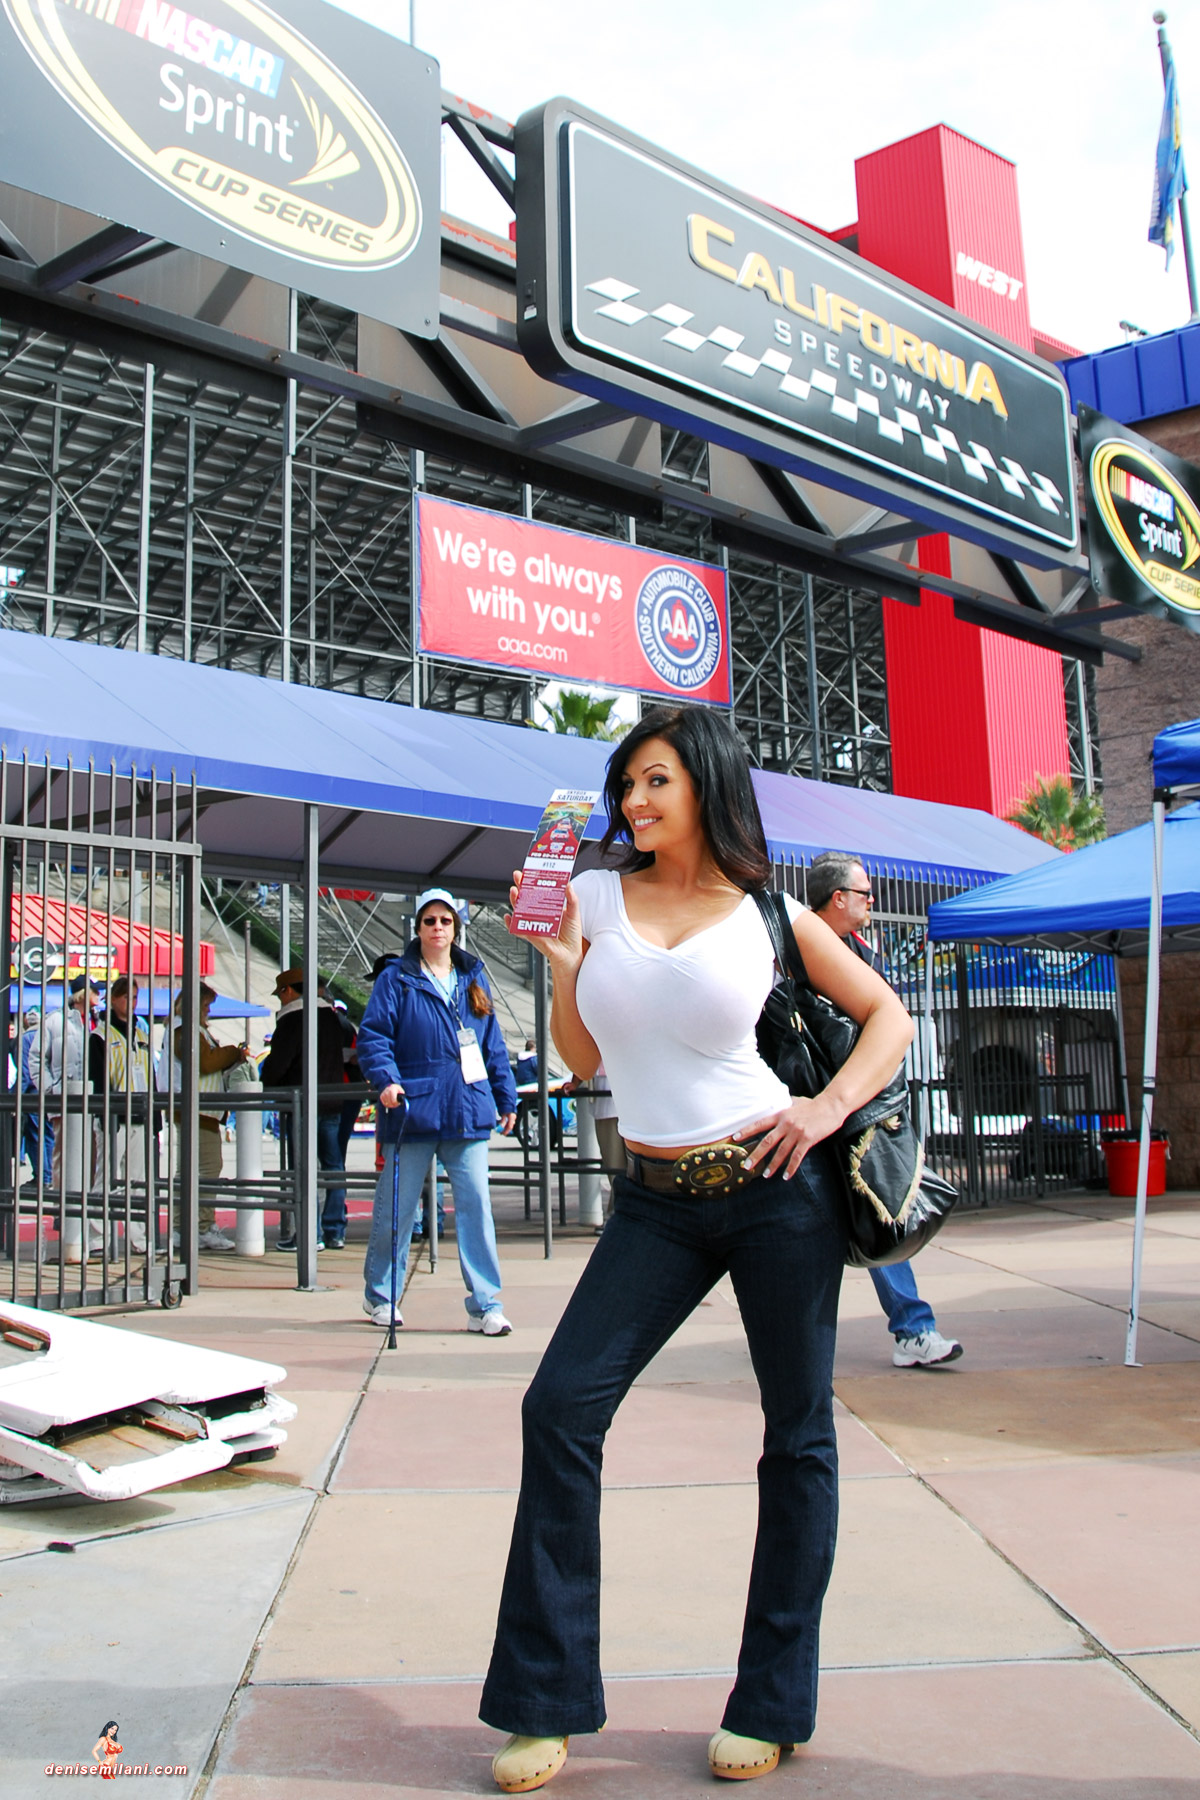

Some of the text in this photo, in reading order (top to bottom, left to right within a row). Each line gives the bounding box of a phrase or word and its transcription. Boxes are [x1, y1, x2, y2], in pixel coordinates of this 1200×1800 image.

[135, 3, 278, 96] NASCAR
[158, 62, 295, 163] Sprint
[170, 157, 374, 254] CUP SERIES
[955, 251, 1024, 301] WEST
[687, 212, 1009, 419] CALIFORNIA
[773, 317, 952, 421] SPEEDWAY
[1138, 512, 1182, 558] Sprint
[524, 552, 622, 604] always
[640, 570, 715, 623] AUTOMOBILE CLUB
[1150, 566, 1172, 584] CUP
[466, 586, 526, 624] with
[660, 608, 699, 641] AAA
[497, 635, 568, 663] aaa.com
[639, 614, 719, 685] SOUTHERN CALIFORNIA
[556, 794, 594, 802] SATURDAY
[517, 919, 554, 933] ENTRY
[78, 954, 116, 969] GEAR
